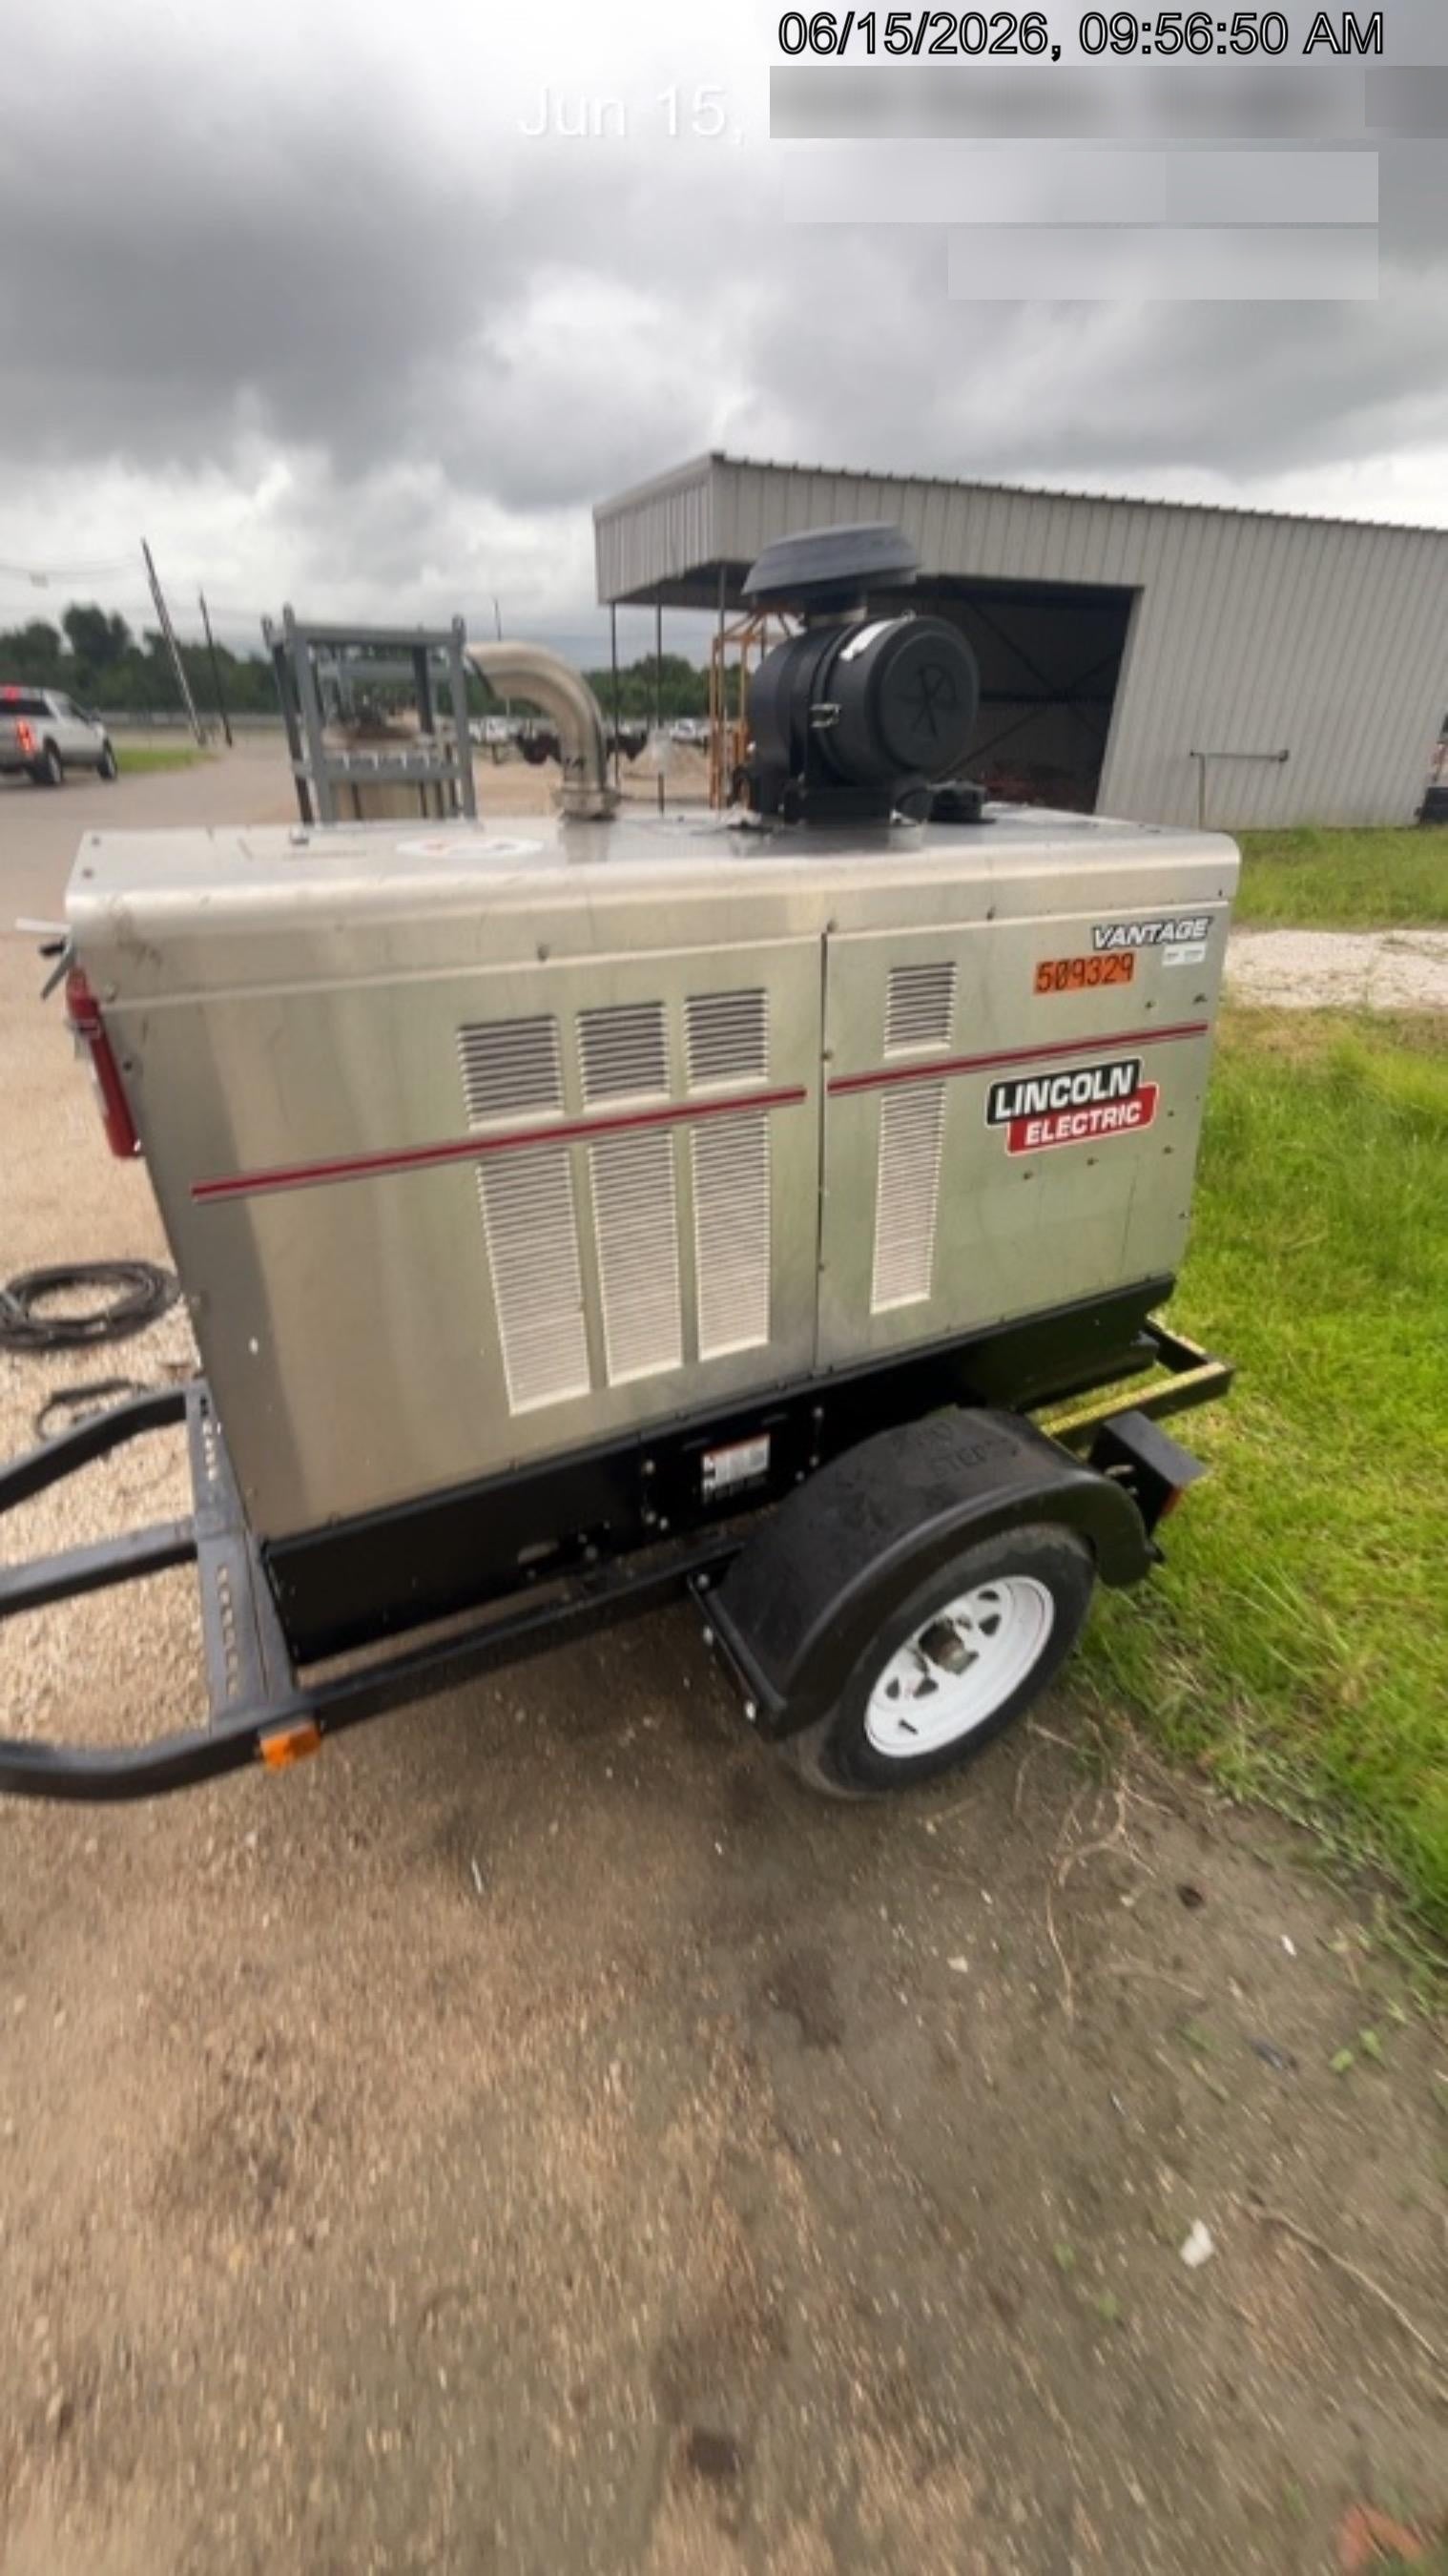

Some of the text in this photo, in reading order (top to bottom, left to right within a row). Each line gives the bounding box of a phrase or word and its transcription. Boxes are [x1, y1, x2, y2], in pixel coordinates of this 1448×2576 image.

[1093, 918, 1211, 949] VANTAGE
[1036, 952, 1135, 993] 509329
[994, 1064, 1134, 1120] LINCOLN
[1024, 1100, 1144, 1147] ELECTRIC
